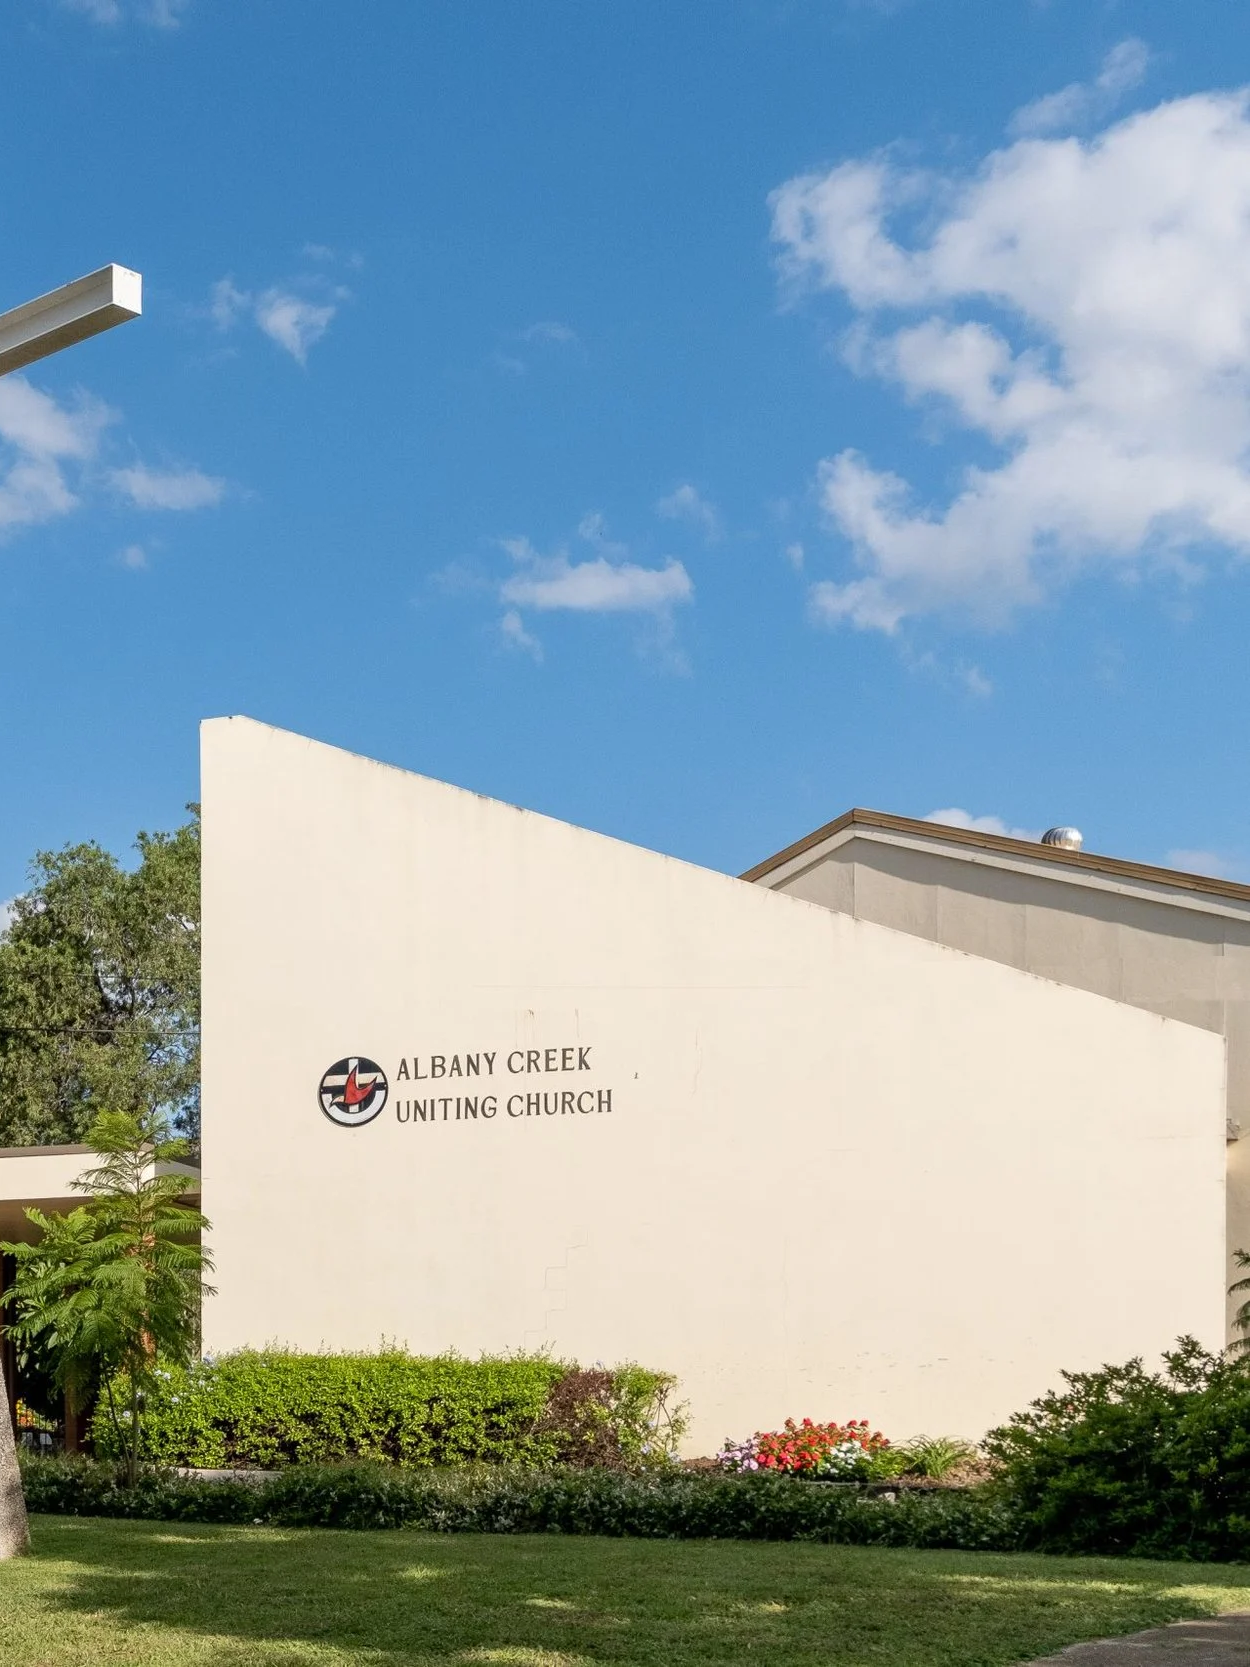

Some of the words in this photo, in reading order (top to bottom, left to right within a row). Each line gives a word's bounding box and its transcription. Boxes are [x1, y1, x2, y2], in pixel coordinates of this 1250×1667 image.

[396, 1052, 497, 1081] ALBANY
[507, 1047, 592, 1074] CREEK
[396, 1096, 498, 1123] UNITING
[507, 1089, 613, 1118] CHURCH
